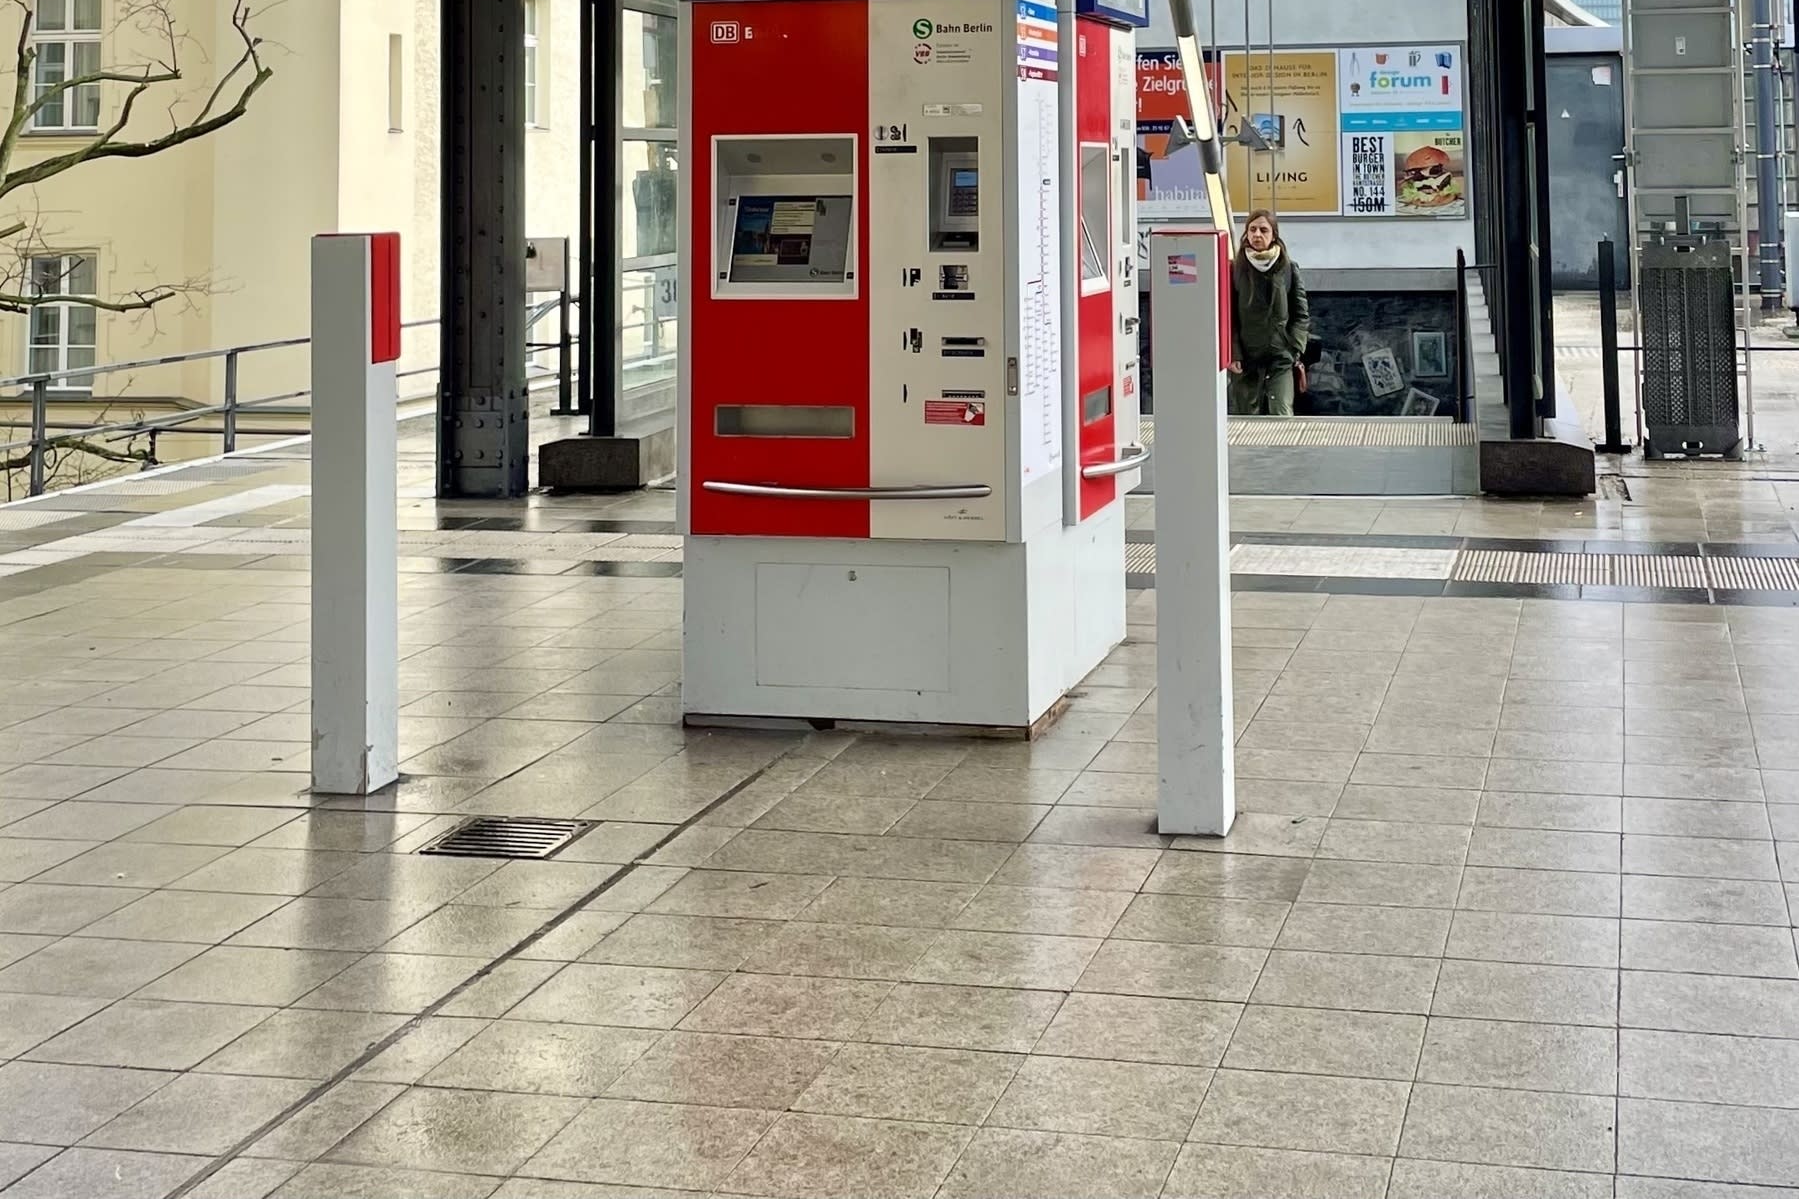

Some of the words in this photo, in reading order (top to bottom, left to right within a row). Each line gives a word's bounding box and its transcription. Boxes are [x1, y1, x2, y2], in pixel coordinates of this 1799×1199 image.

[713, 23, 737, 41] DB
[936, 23, 961, 34] Bahn
[963, 22, 993, 33] Berlin
[1136, 54, 1160, 71] fen
[1370, 71, 1432, 88] forum
[1352, 136, 1384, 153] BEST
[1352, 153, 1385, 164] BURGER
[1352, 163, 1361, 174] IN
[1363, 163, 1385, 174] TOWN
[1154, 185, 1207, 200] habita
[1353, 186, 1367, 197] NO.
[1370, 186, 1385, 197] 144
